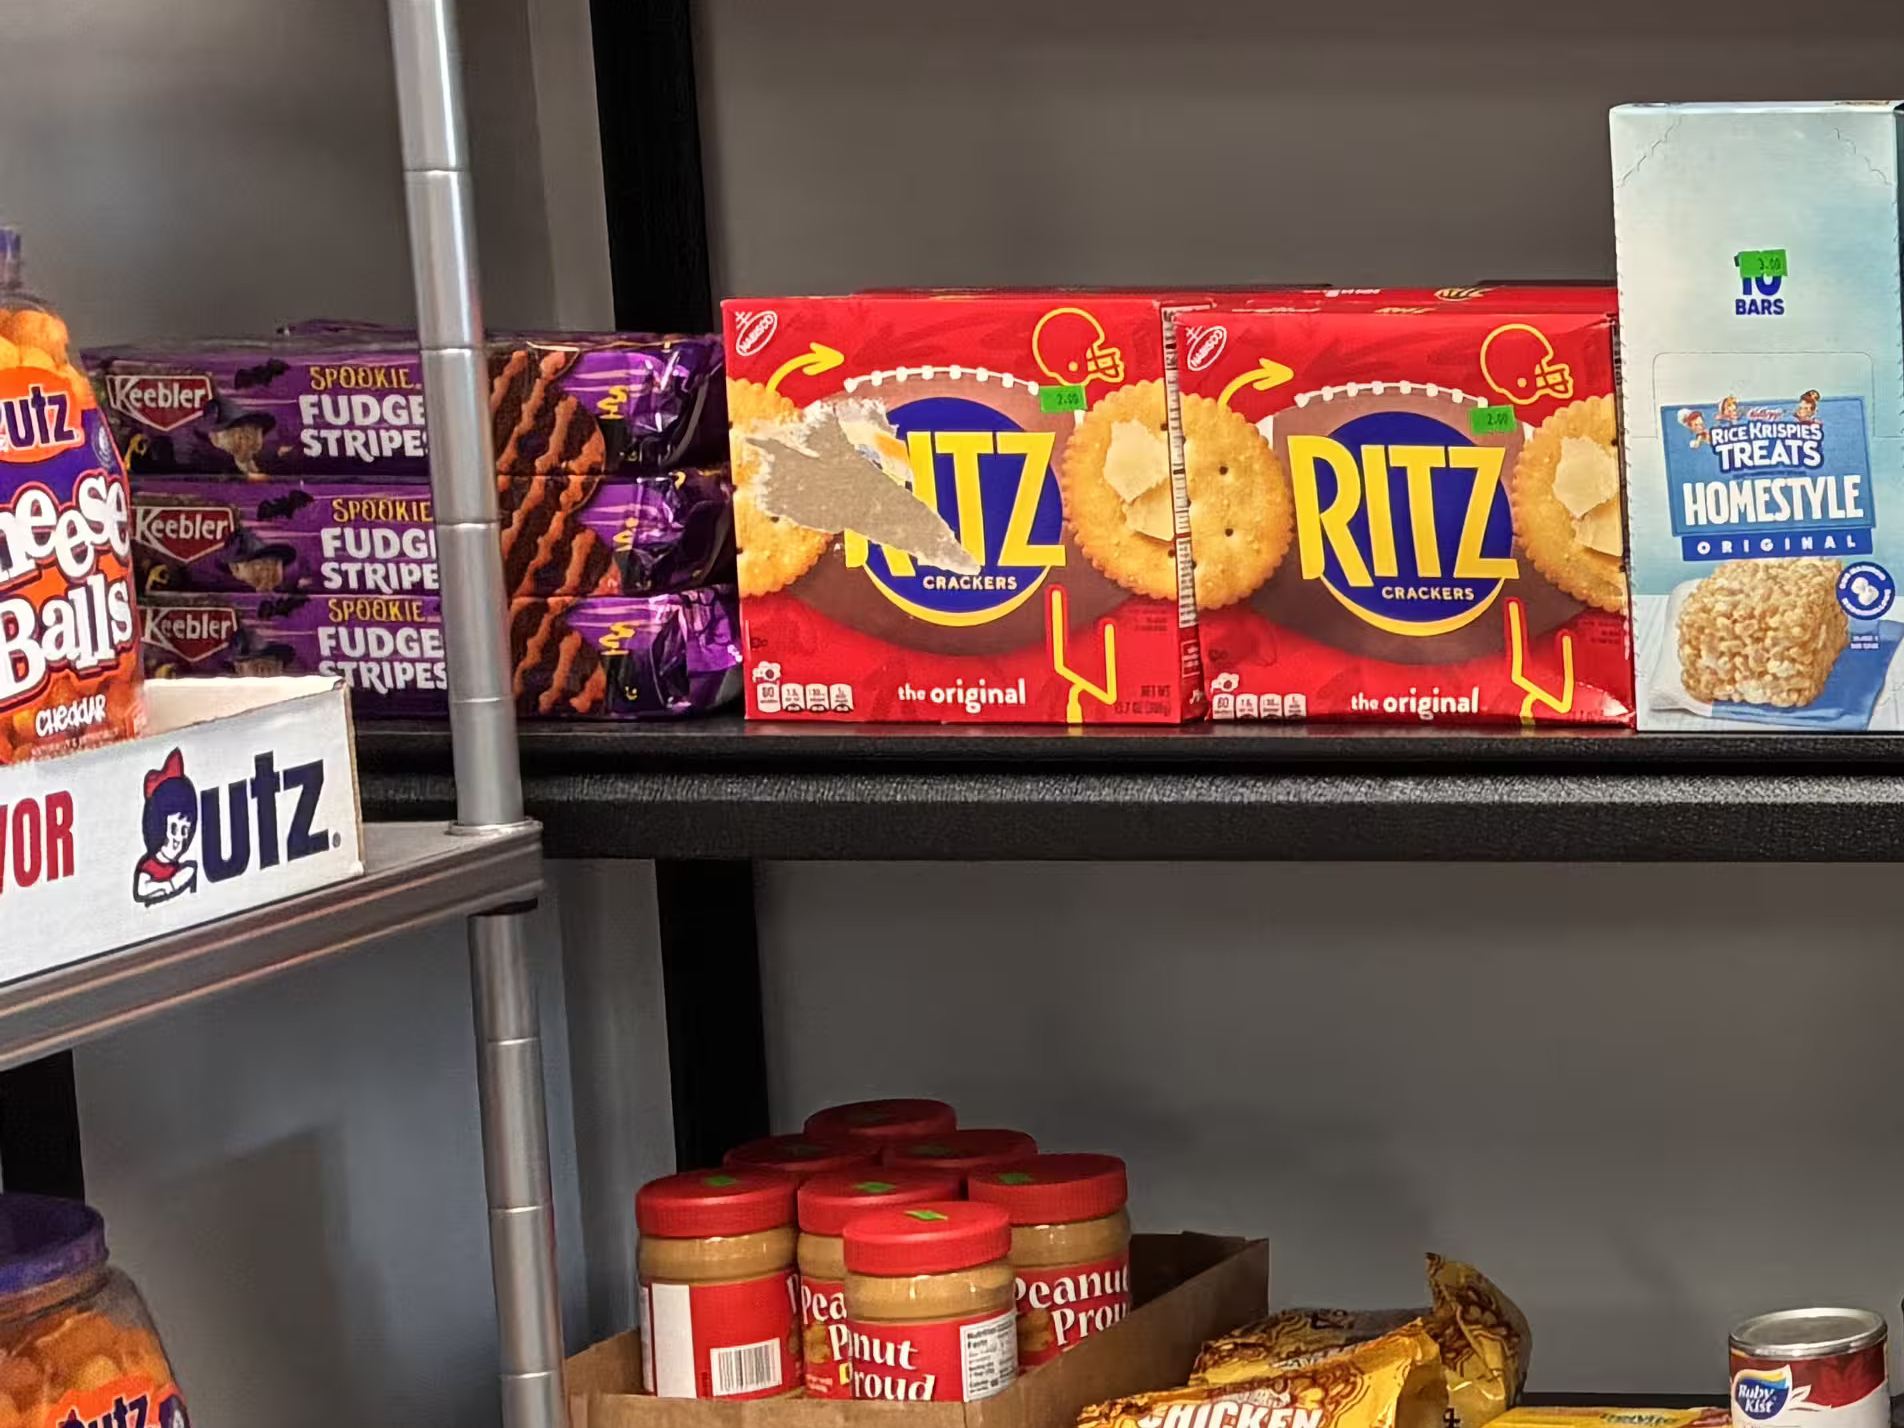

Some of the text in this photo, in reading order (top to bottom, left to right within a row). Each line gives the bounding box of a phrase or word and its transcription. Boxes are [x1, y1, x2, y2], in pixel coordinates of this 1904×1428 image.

[1735, 299, 1785, 316] BARS
[114, 376, 208, 413] Keebler
[299, 394, 426, 428] FUDGE
[1711, 421, 1822, 444] RICE KRISPIES
[1716, 439, 1822, 470] TREATS
[1288, 434, 1519, 587] RITZ
[1683, 476, 1864, 525] HOMESTYLE
[136, 506, 232, 541] Keebler
[1696, 534, 1858, 555] ORIGINAL
[923, 574, 1018, 592] CRACKERS
[1381, 586, 1475, 602] CRACKERS
[318, 628, 443, 660] FUDGE
[898, 678, 1028, 710] the original
[1351, 689, 1479, 718] the original
[1738, 1385, 1775, 1403] Ruby
